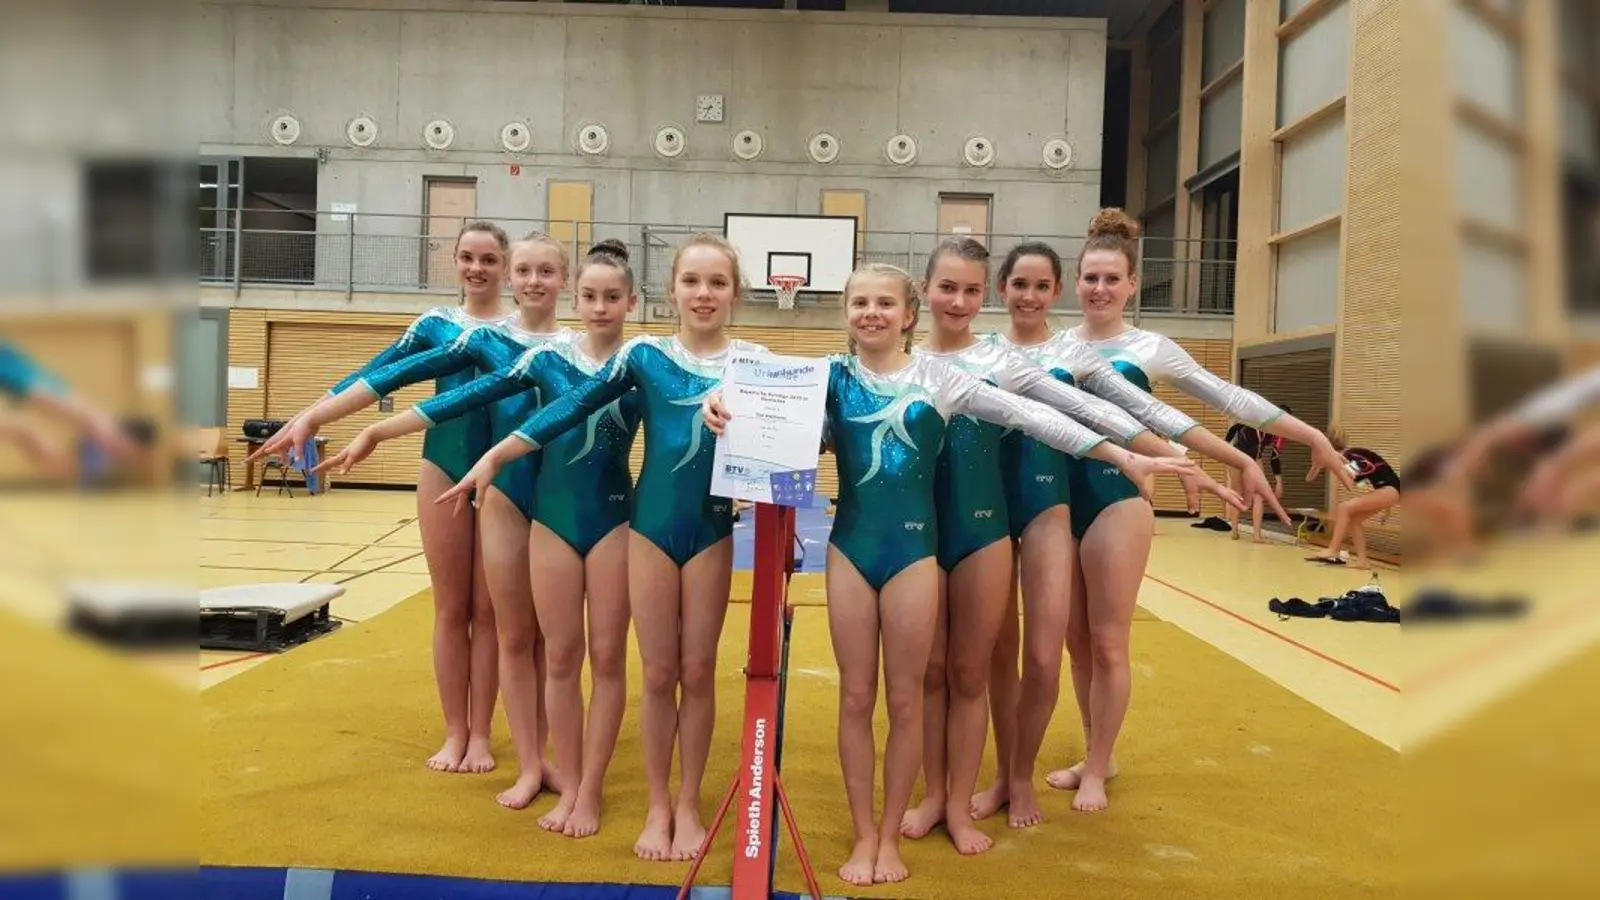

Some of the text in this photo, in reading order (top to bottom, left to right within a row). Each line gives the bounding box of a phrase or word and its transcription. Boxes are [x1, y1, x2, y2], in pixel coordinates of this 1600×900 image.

[725, 464, 744, 474] BTV
[745, 718, 766, 858] Spieth Anderson
